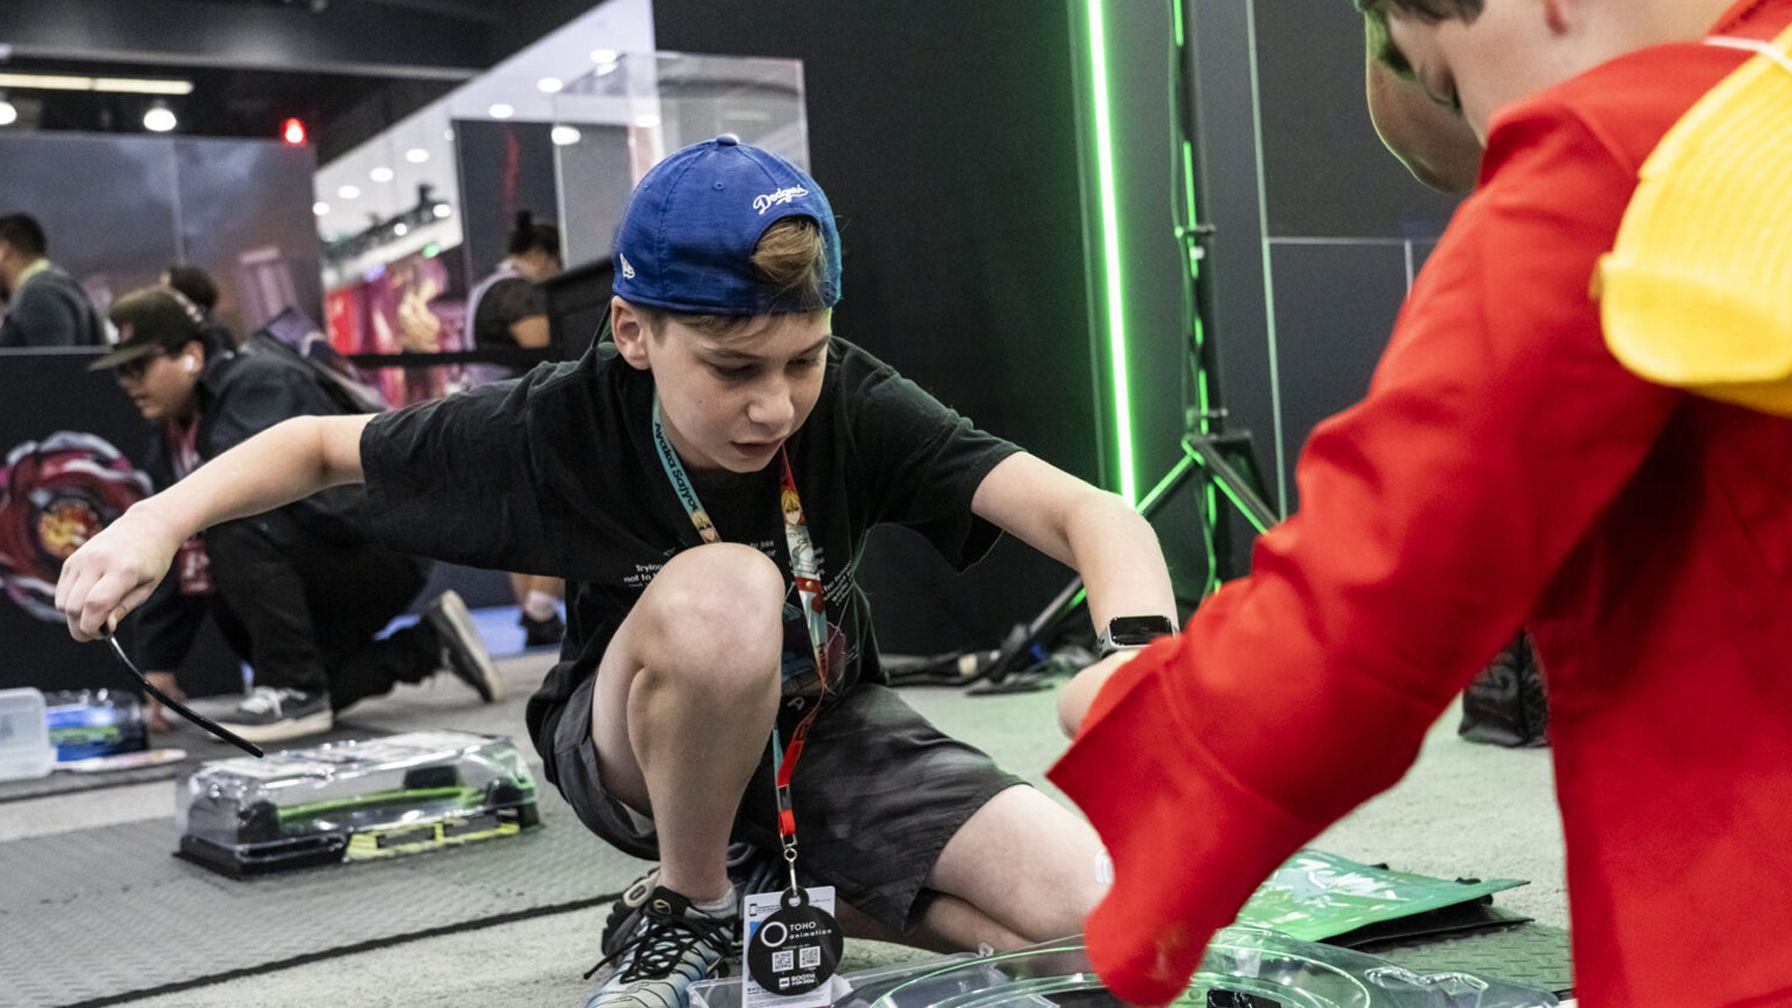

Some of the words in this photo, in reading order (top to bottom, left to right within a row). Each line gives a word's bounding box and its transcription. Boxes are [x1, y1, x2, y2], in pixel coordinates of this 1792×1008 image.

[753, 184, 808, 214] Dodgers
[655, 422, 677, 468] Ayaka
[789, 929, 832, 940] animation
[790, 921, 816, 931] TOHO
